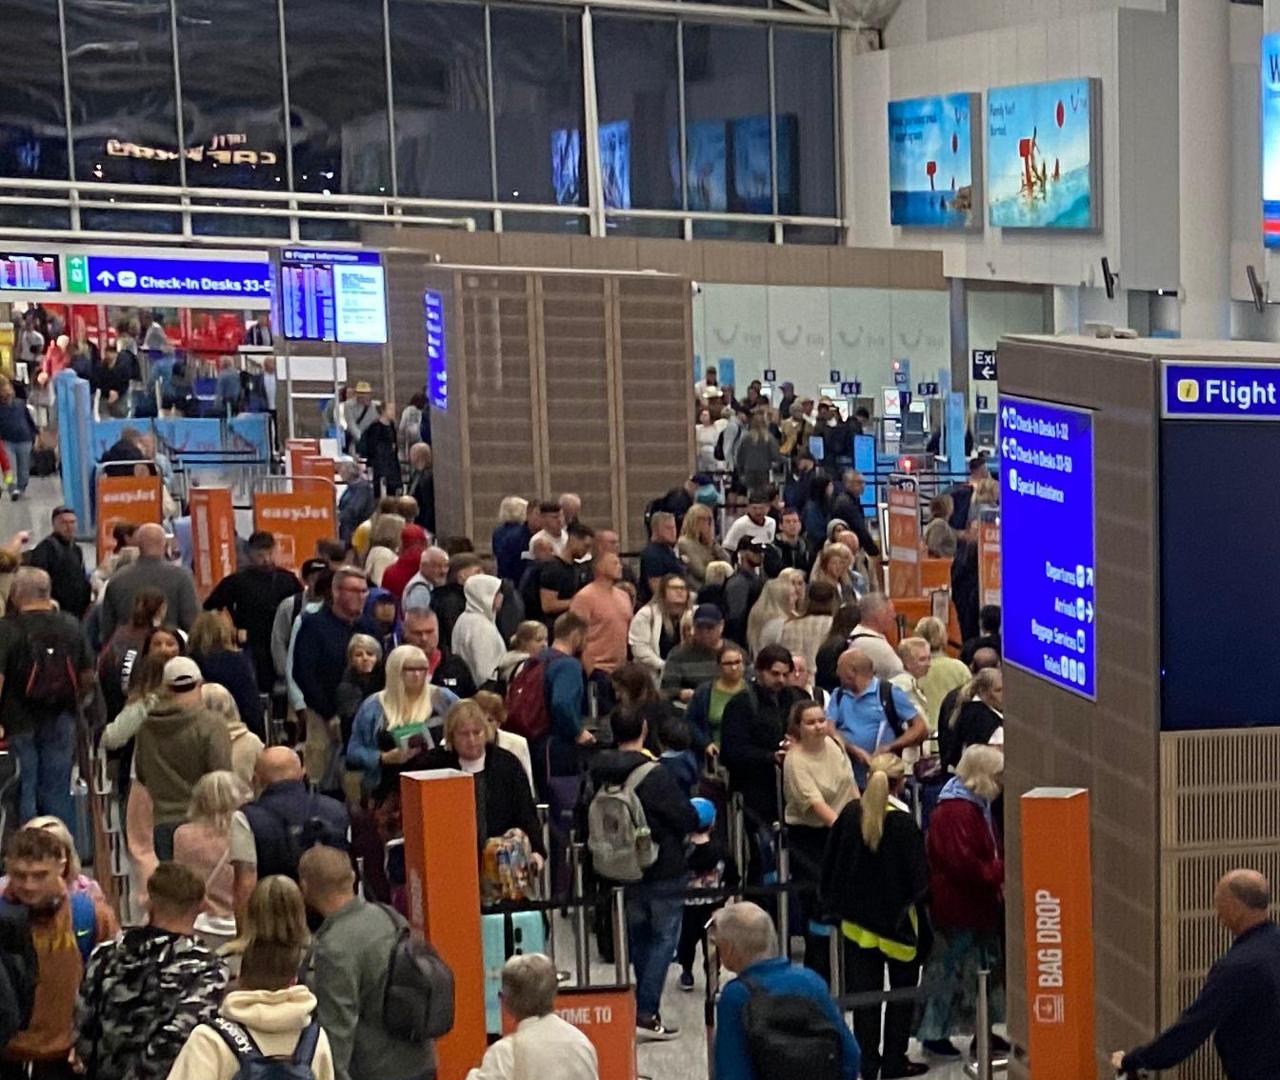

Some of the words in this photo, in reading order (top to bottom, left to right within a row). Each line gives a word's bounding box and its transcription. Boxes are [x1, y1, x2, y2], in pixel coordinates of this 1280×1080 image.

[140, 276, 200, 290] Check-In
[201, 278, 242, 291] Desks
[1206, 380, 1277, 410] Flight
[263, 505, 329, 521] easyJet
[1035, 889, 1062, 943] DROP
[1038, 949, 1063, 987] BAG
[558, 1007, 592, 1024] OME
[594, 1006, 612, 1024] TO
